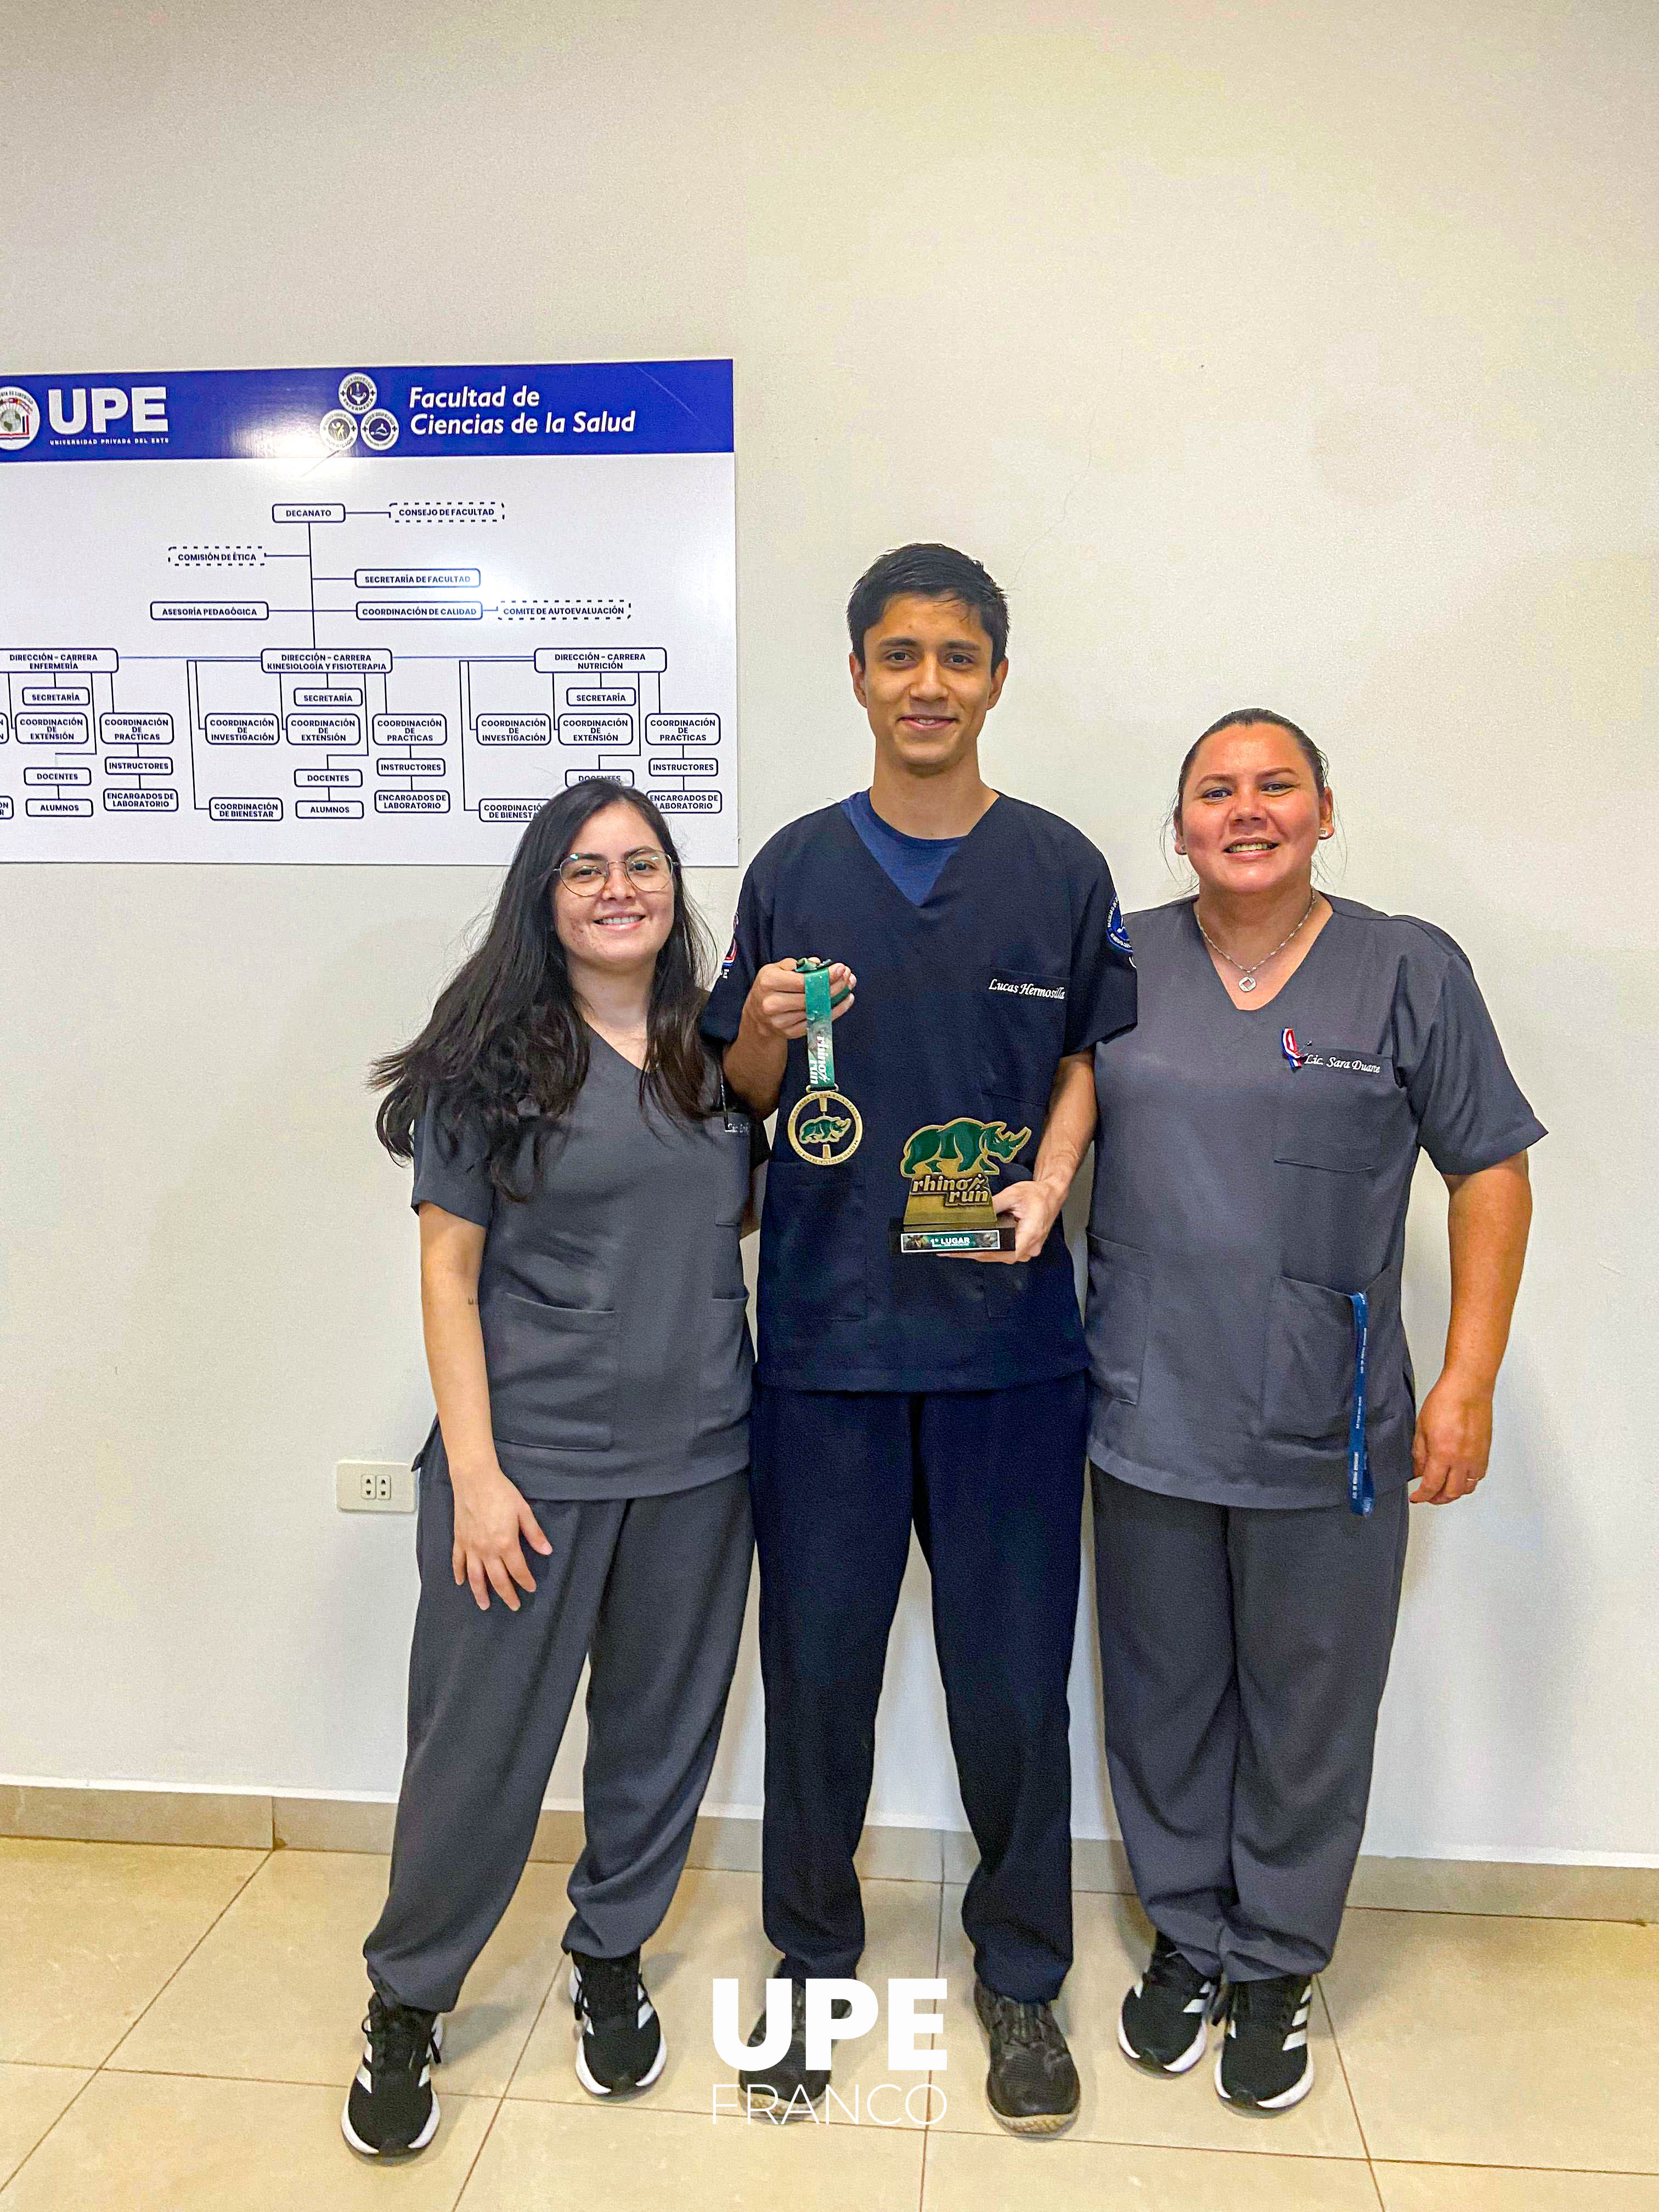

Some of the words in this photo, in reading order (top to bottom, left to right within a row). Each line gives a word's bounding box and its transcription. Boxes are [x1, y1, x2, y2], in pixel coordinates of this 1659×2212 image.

[409, 385, 506, 409] Facultad
[513, 385, 540, 407] de
[48, 386, 169, 435] UPE
[410, 413, 504, 435] Ciencias
[511, 412, 538, 434] de
[545, 411, 566, 433] la
[573, 410, 636, 433] Salud
[286, 509, 332, 517] DECANATO
[178, 552, 220, 561] COMISIÓN
[233, 552, 257, 561] ÉTICA
[365, 574, 414, 583] SECRETARÍA
[162, 607, 202, 616] ASESORÍA
[203, 606, 257, 616] PEDAGÓGICA
[362, 606, 427, 616] COORDINACIÓN
[549, 605, 624, 614] AUTOEVALUACIÓN
[9, 652, 54, 661] DIRECCIÓN
[281, 652, 326, 661] DIRECCIÓN
[554, 652, 600, 661] DIRECCIÓN
[30, 662, 79, 670] ENFERMERÍA
[267, 661, 324, 670] KINESIOLOGÍA
[578, 661, 623, 670] NUTRICIÓN
[32, 692, 80, 701] SECRETARÍA
[304, 693, 353, 702] SECRETARÍA
[576, 693, 626, 702] SECRETARÍA
[20, 716, 83, 726] COORDINACIÓN
[104, 716, 168, 726] COORDINACIÓN
[210, 718, 274, 727] COORDINACIÓN
[291, 718, 356, 727] COORDINACIÓN
[377, 718, 442, 727] COORDINACIÓN
[481, 718, 546, 727] COORDINACIÓN
[563, 717, 628, 727] COORDINACIÓN
[650, 717, 715, 727] COORDINACIÓN
[30, 732, 75, 740] EXTENSIÓN
[211, 732, 274, 741] INVESTIGACIÓN
[301, 733, 346, 741] EXTENSIÓN
[482, 733, 546, 742] INVESTIGACIÓN
[573, 732, 619, 741] EXTENSIÓN
[214, 802, 278, 810] COORDINACIÓN
[484, 803, 542, 811] COORDINACIÓ
[989, 979, 1019, 994] Lucas
[1019, 984, 1065, 1000] Hermosilla
[816, 1035, 829, 1074] rhino
[1327, 1057, 1351, 1069] Sara
[809, 1059, 819, 1085] run
[912, 1175, 970, 1192] rhino
[949, 1189, 989, 1203] run
[940, 1237, 970, 1245] LUGAR
